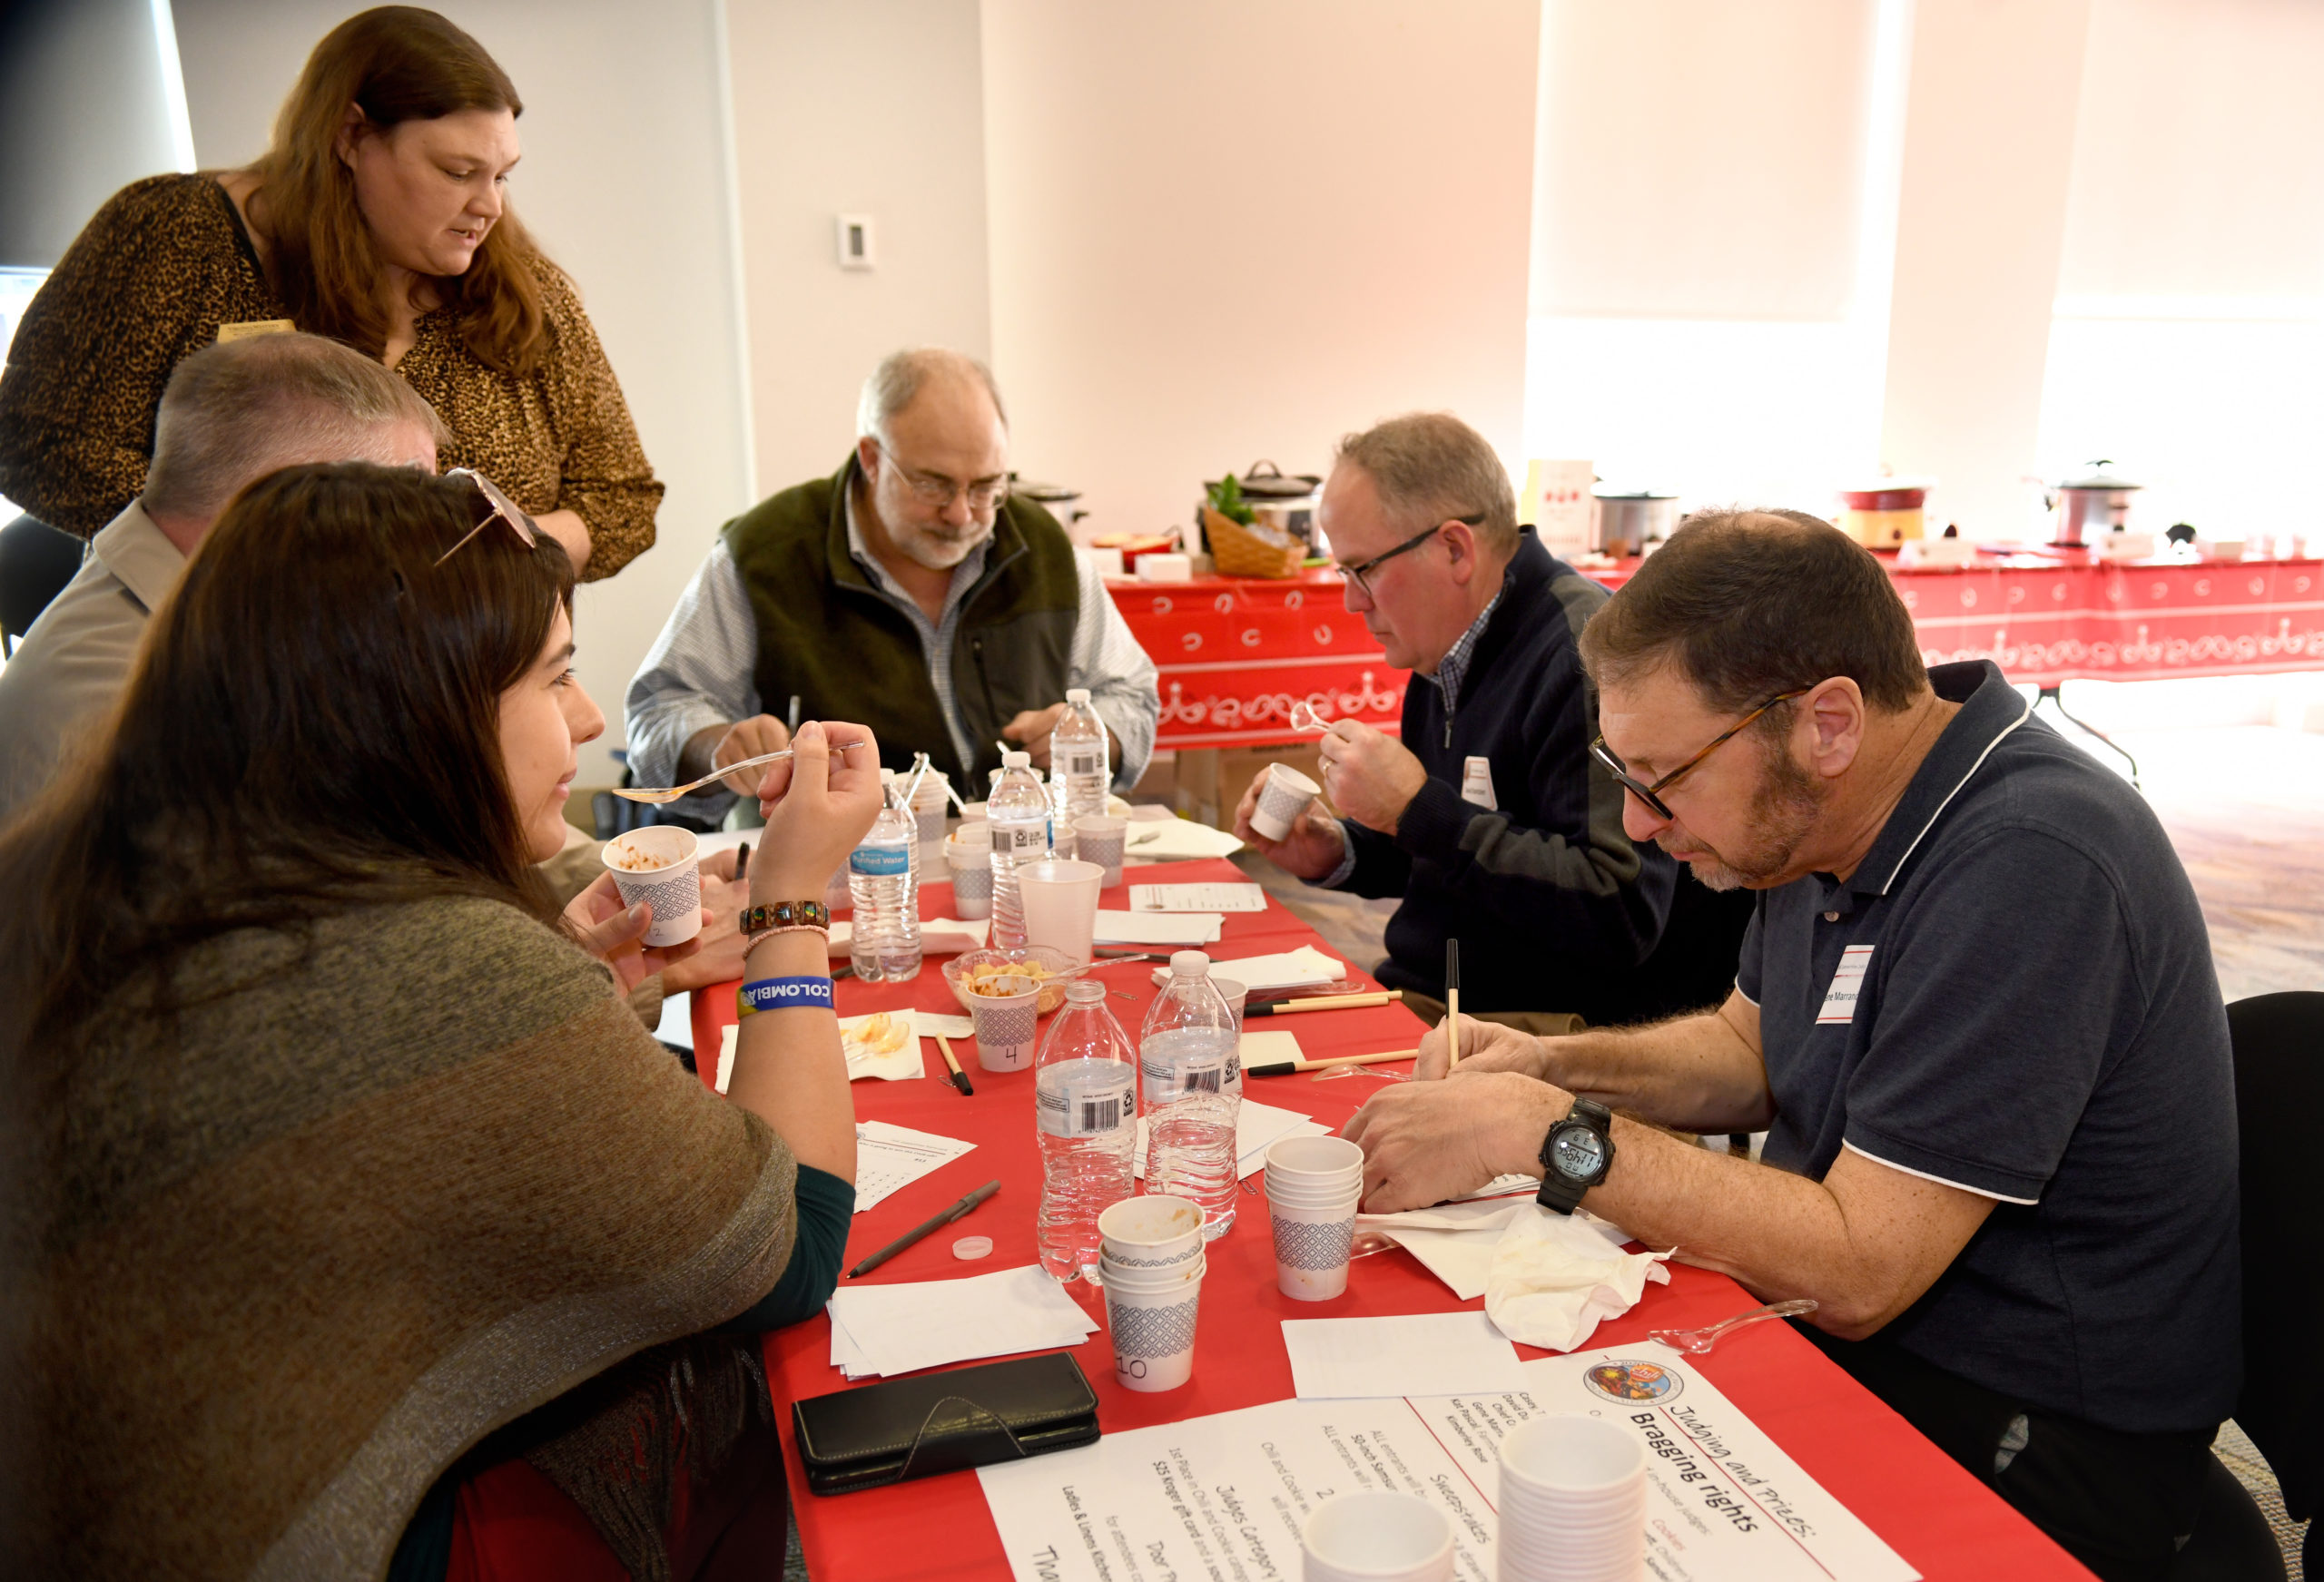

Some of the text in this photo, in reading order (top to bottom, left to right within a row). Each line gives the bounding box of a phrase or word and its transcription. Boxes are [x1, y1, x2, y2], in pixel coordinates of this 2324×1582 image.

[852, 855, 881, 865] Purified
[747, 984, 830, 1000] COLOMBIA
[1006, 1046, 1017, 1064] 4
[1116, 1356, 1147, 1380] 10
[1451, 1399, 1463, 1410] Kat
[1472, 1401, 1489, 1418] Gene
[1492, 1403, 1512, 1419] Chief
[1502, 1394, 1523, 1411] David
[1169, 1447, 1184, 1459] 1st
[1351, 1434, 1378, 1462] 50-inch
[1445, 1416, 1488, 1463] Kimberley Rose
[1322, 1425, 1338, 1438] ALL
[1331, 1439, 1358, 1469] entrants
[1354, 1469, 1372, 1485] will
[1370, 1430, 1387, 1443] ALL
[1380, 1443, 1408, 1474] entrants
[1403, 1475, 1423, 1489] will
[1177, 1459, 1193, 1479] Place
[1262, 1441, 1280, 1459] Chili
[1271, 1459, 1291, 1474] and
[1282, 1474, 1305, 1502] Cookie
[1630, 1412, 1759, 1533] Bragging rights
[1670, 1405, 1817, 1538] Judging and Prizes:
[1187, 1479, 1199, 1490] in
[1316, 1489, 1334, 1499] 2
[1062, 1485, 1080, 1512] Ladles
[1153, 1460, 1171, 1476] $25
[1162, 1476, 1182, 1503] Kroger
[1173, 1505, 1193, 1519] gift
[1184, 1519, 1204, 1539] card
[1194, 1539, 1213, 1557] and
[1192, 1490, 1212, 1508] Chili
[1430, 1474, 1491, 1545] Sweepstakes
[1075, 1512, 1088, 1521] &
[1106, 1515, 1118, 1528] for
[1202, 1508, 1220, 1525] and
[1271, 1496, 1304, 1541] will receive
[1078, 1521, 1097, 1550] Linens
[1212, 1525, 1235, 1555] Cookie
[1216, 1486, 1278, 1579] Judges Category
[1652, 1519, 1686, 1550] Cookies
[1033, 1545, 1060, 1582] Tha
[1111, 1530, 1138, 1572] attendees
[1147, 1540, 1169, 1568] Door
